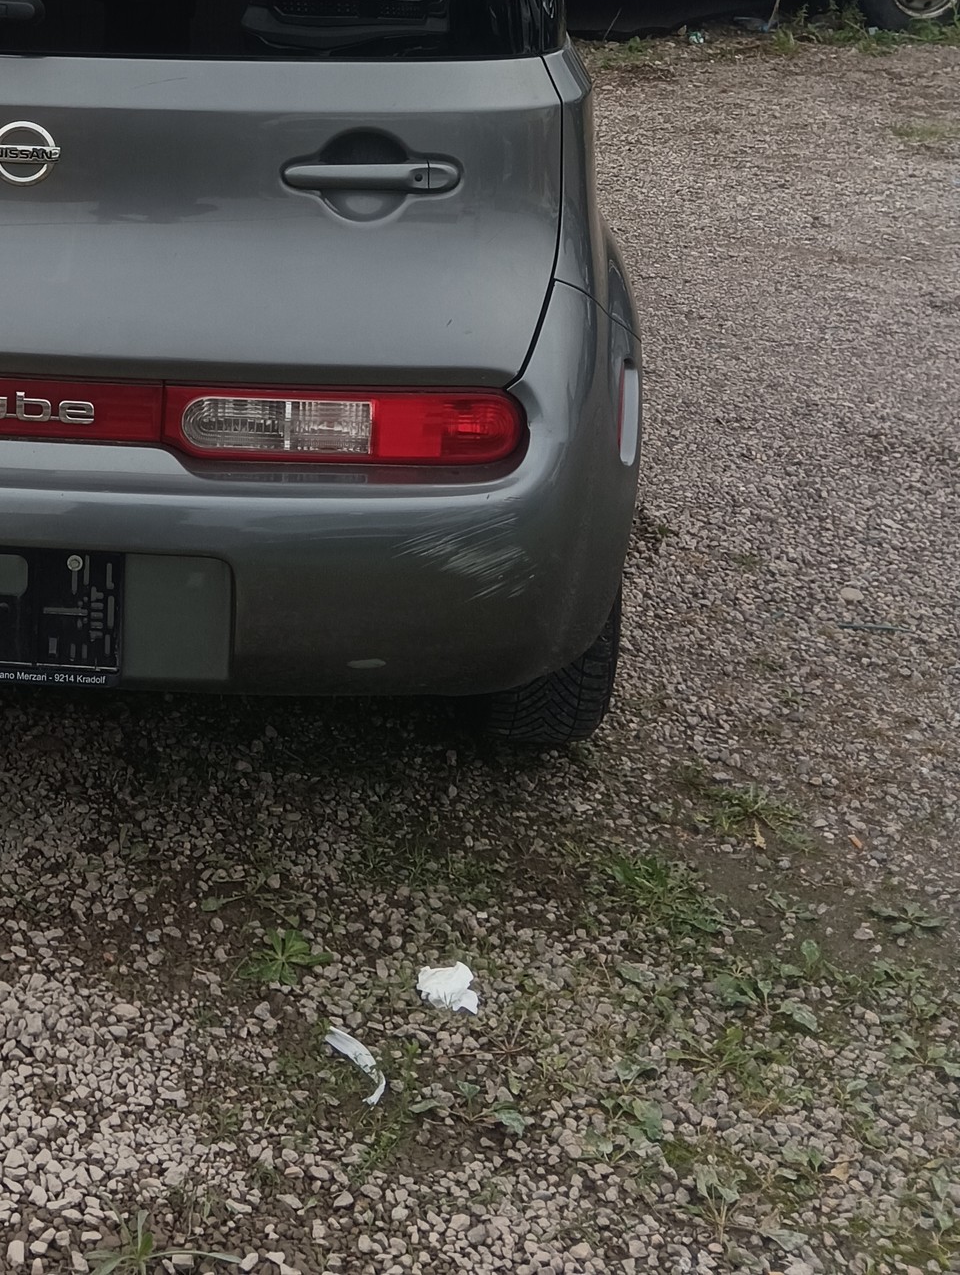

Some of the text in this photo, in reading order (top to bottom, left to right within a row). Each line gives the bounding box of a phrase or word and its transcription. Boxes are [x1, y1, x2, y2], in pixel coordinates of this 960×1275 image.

[16, 671, 48, 682] Merzari
[54, 673, 75, 683] 9214
[76, 674, 106, 685] Kradolf
